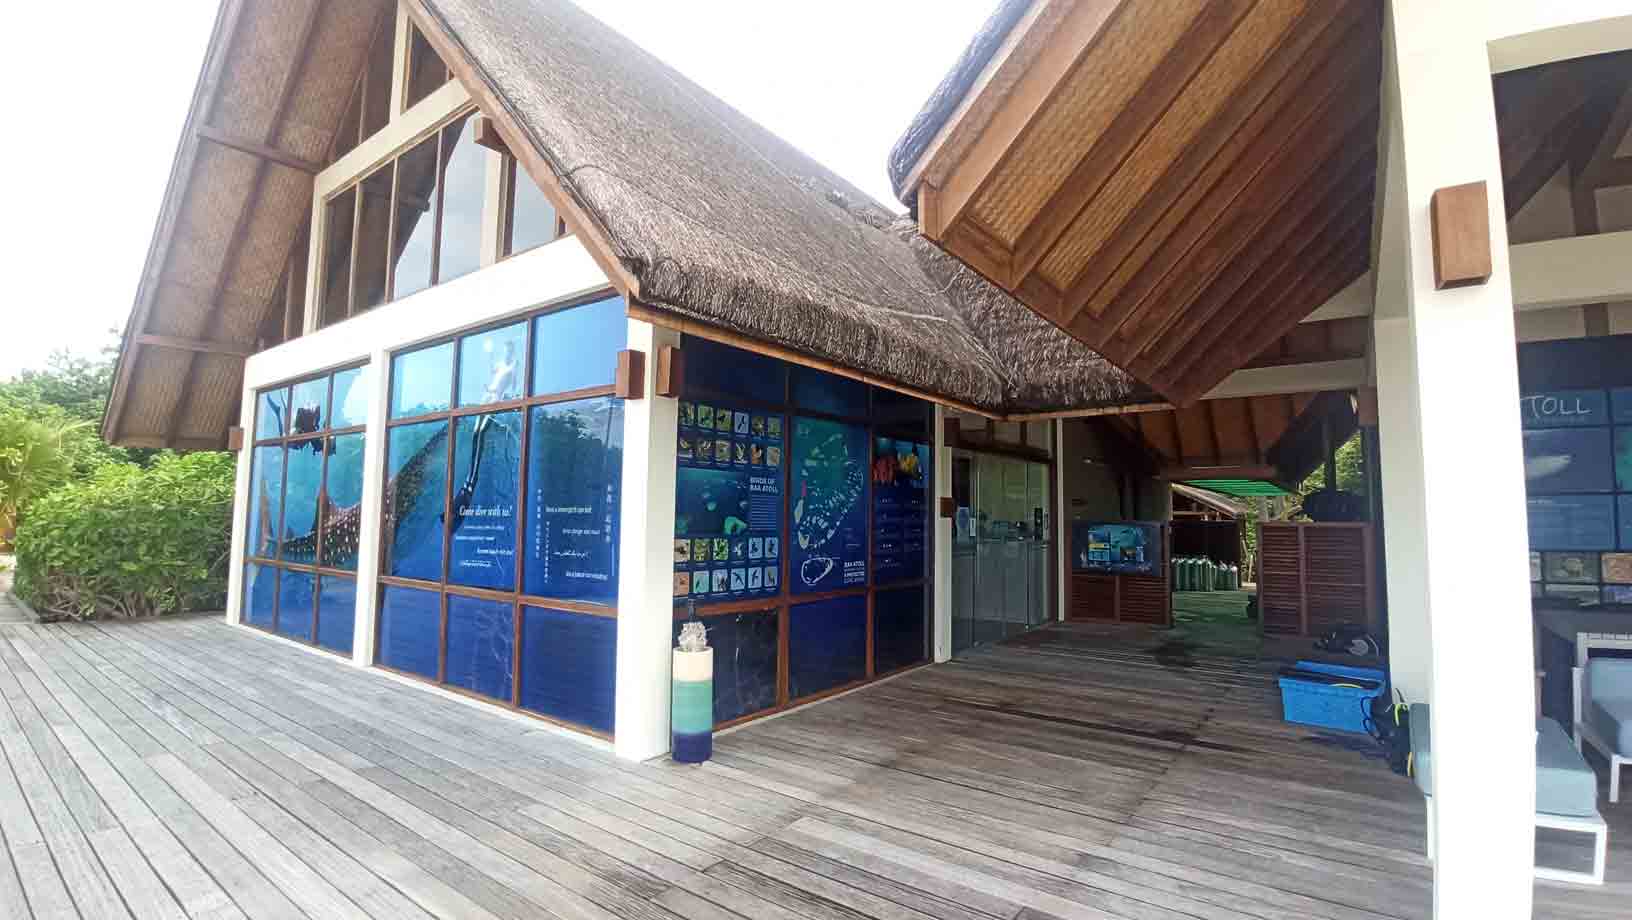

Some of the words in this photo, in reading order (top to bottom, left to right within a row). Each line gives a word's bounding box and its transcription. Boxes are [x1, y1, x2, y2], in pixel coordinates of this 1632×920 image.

[762, 485, 778, 494] ATOLL
[459, 504, 474, 516] Come
[475, 504, 488, 516] dive
[488, 504, 501, 517] with
